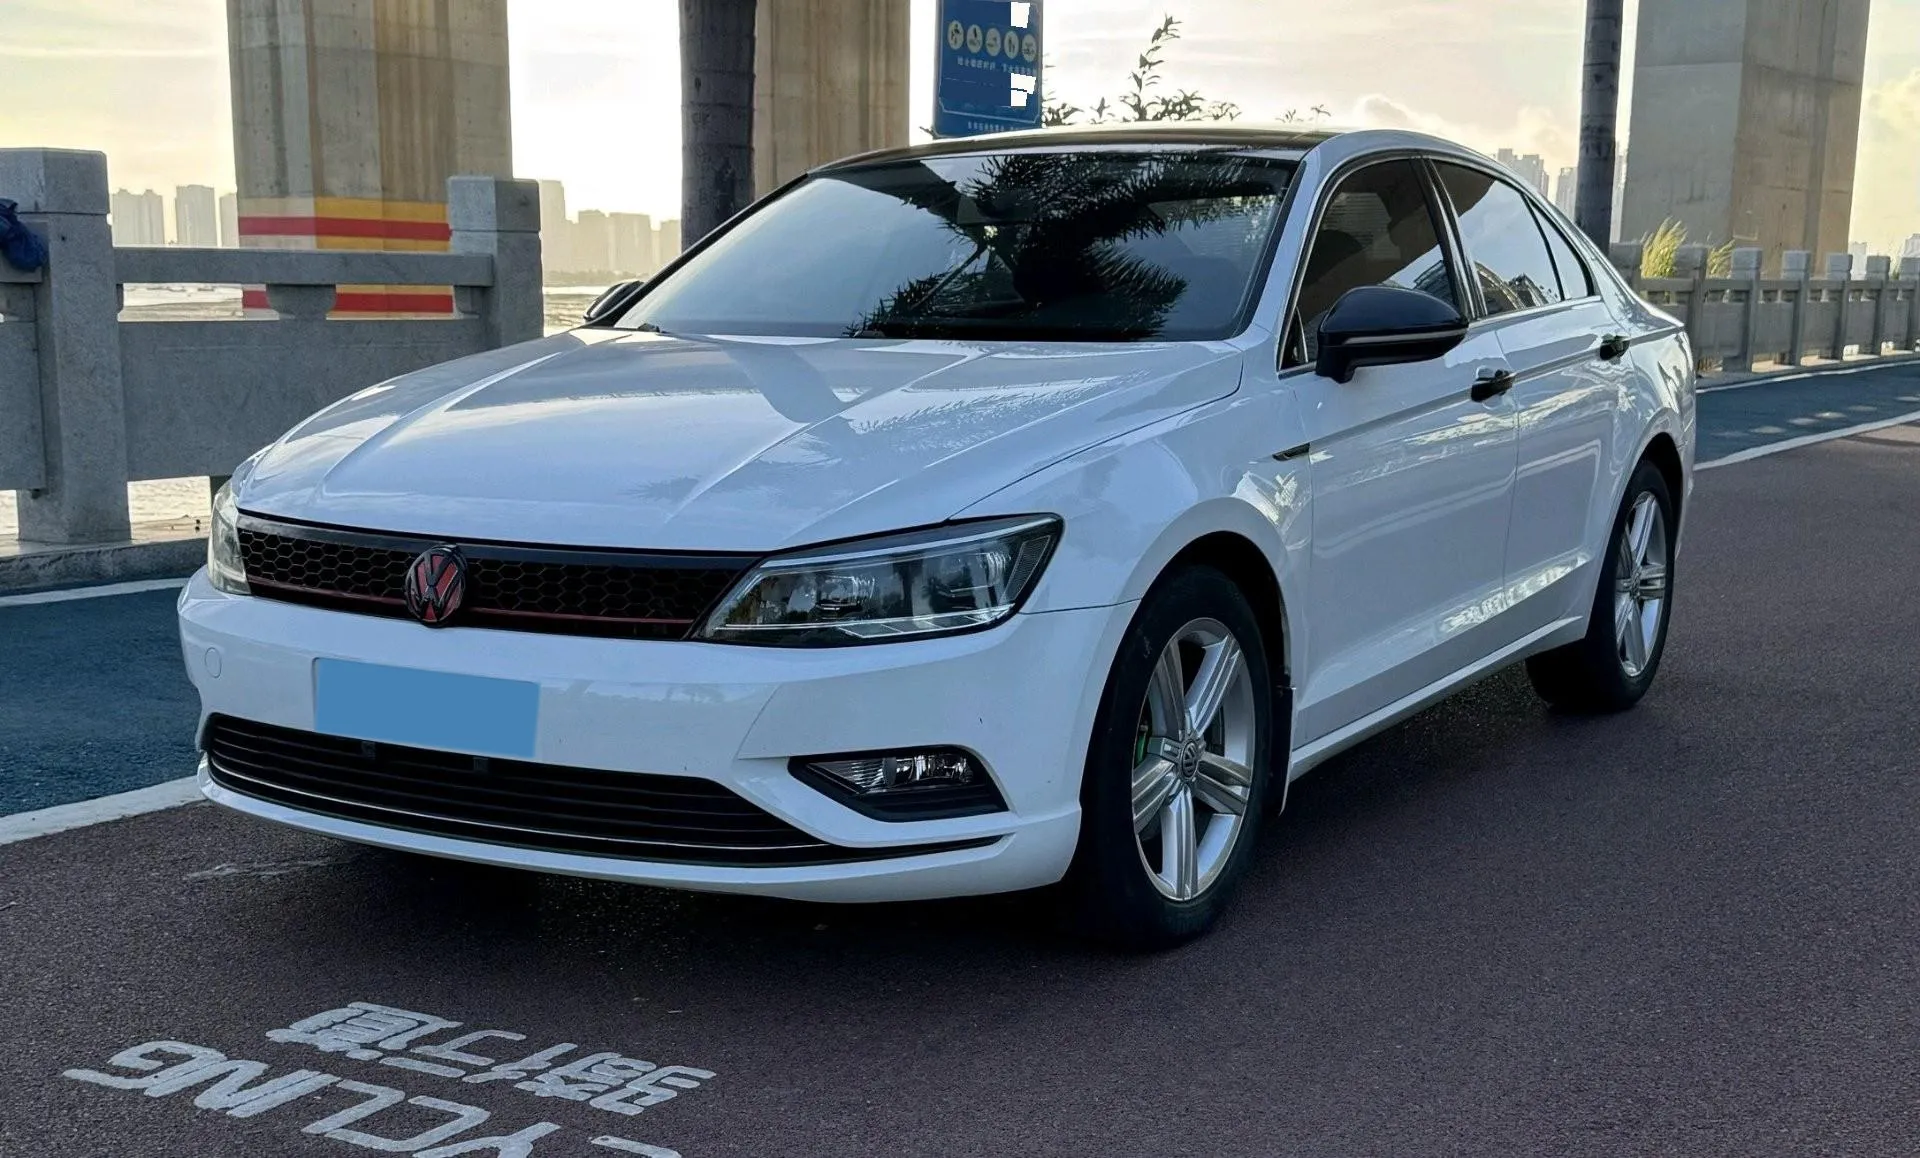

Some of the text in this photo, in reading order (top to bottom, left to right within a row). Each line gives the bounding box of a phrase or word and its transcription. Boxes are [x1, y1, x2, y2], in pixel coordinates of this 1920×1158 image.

[406, 545, 467, 624] VW
[62, 1040, 684, 1158] YCLING
[266, 1001, 716, 1115] 骑行道
